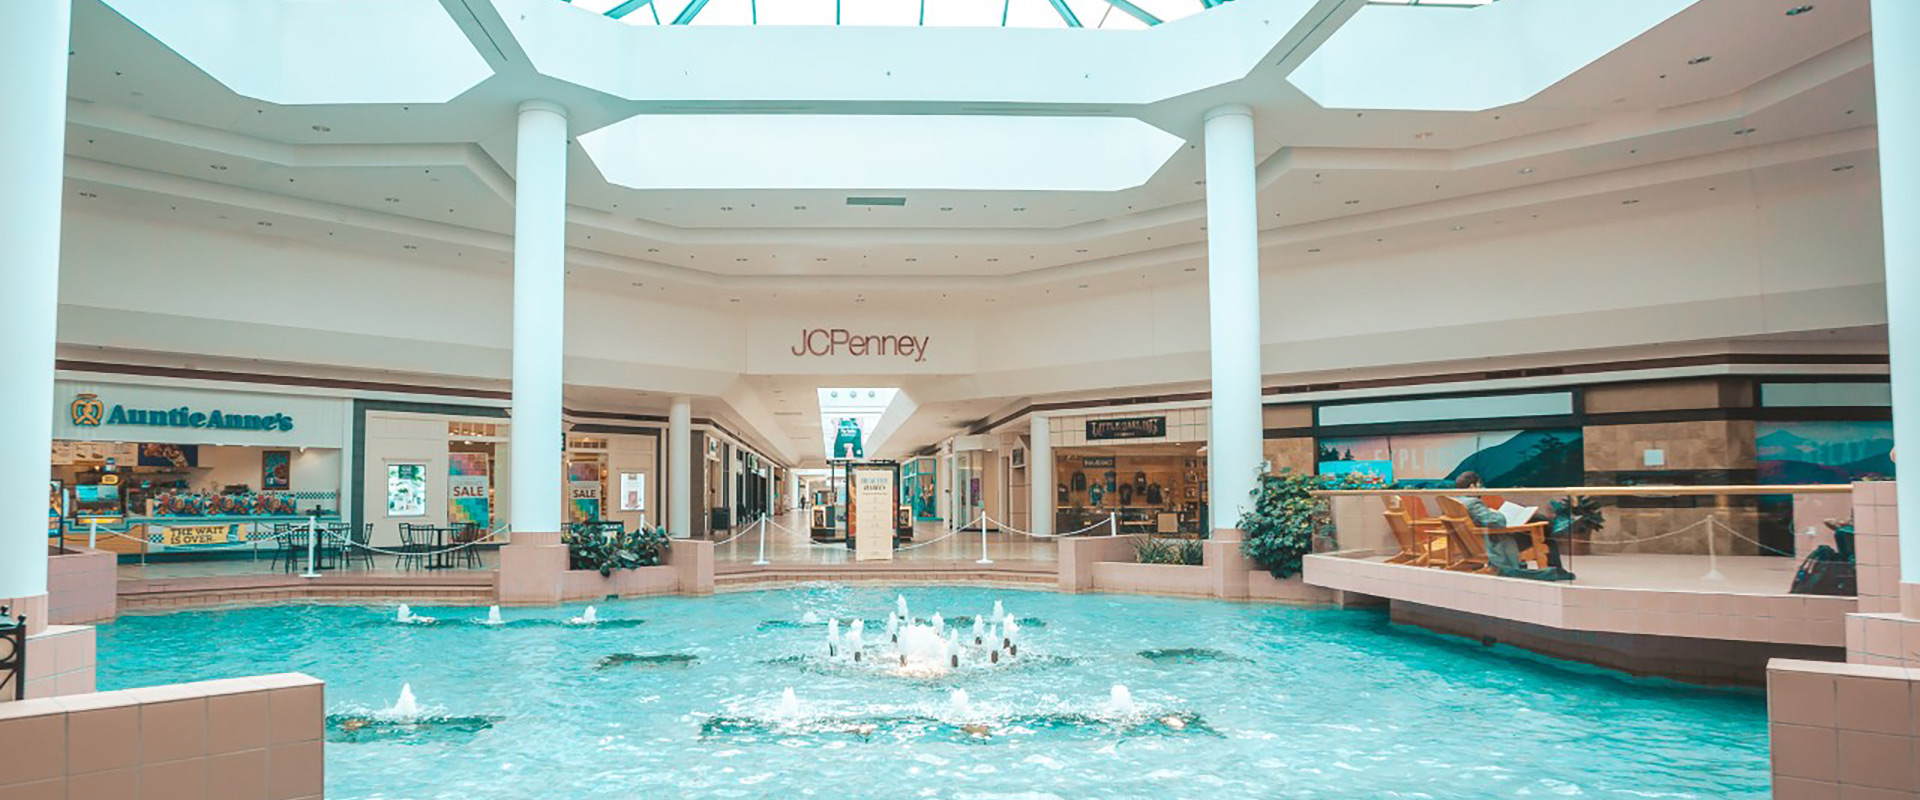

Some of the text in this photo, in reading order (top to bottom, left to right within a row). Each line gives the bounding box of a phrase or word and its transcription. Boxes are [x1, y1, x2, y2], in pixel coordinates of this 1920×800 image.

[792, 329, 929, 362] JCPenney
[453, 486, 484, 496] SALE
[573, 489, 596, 498] SALE
[170, 526, 224, 537] THE WAIT
[170, 536, 181, 544] IS
